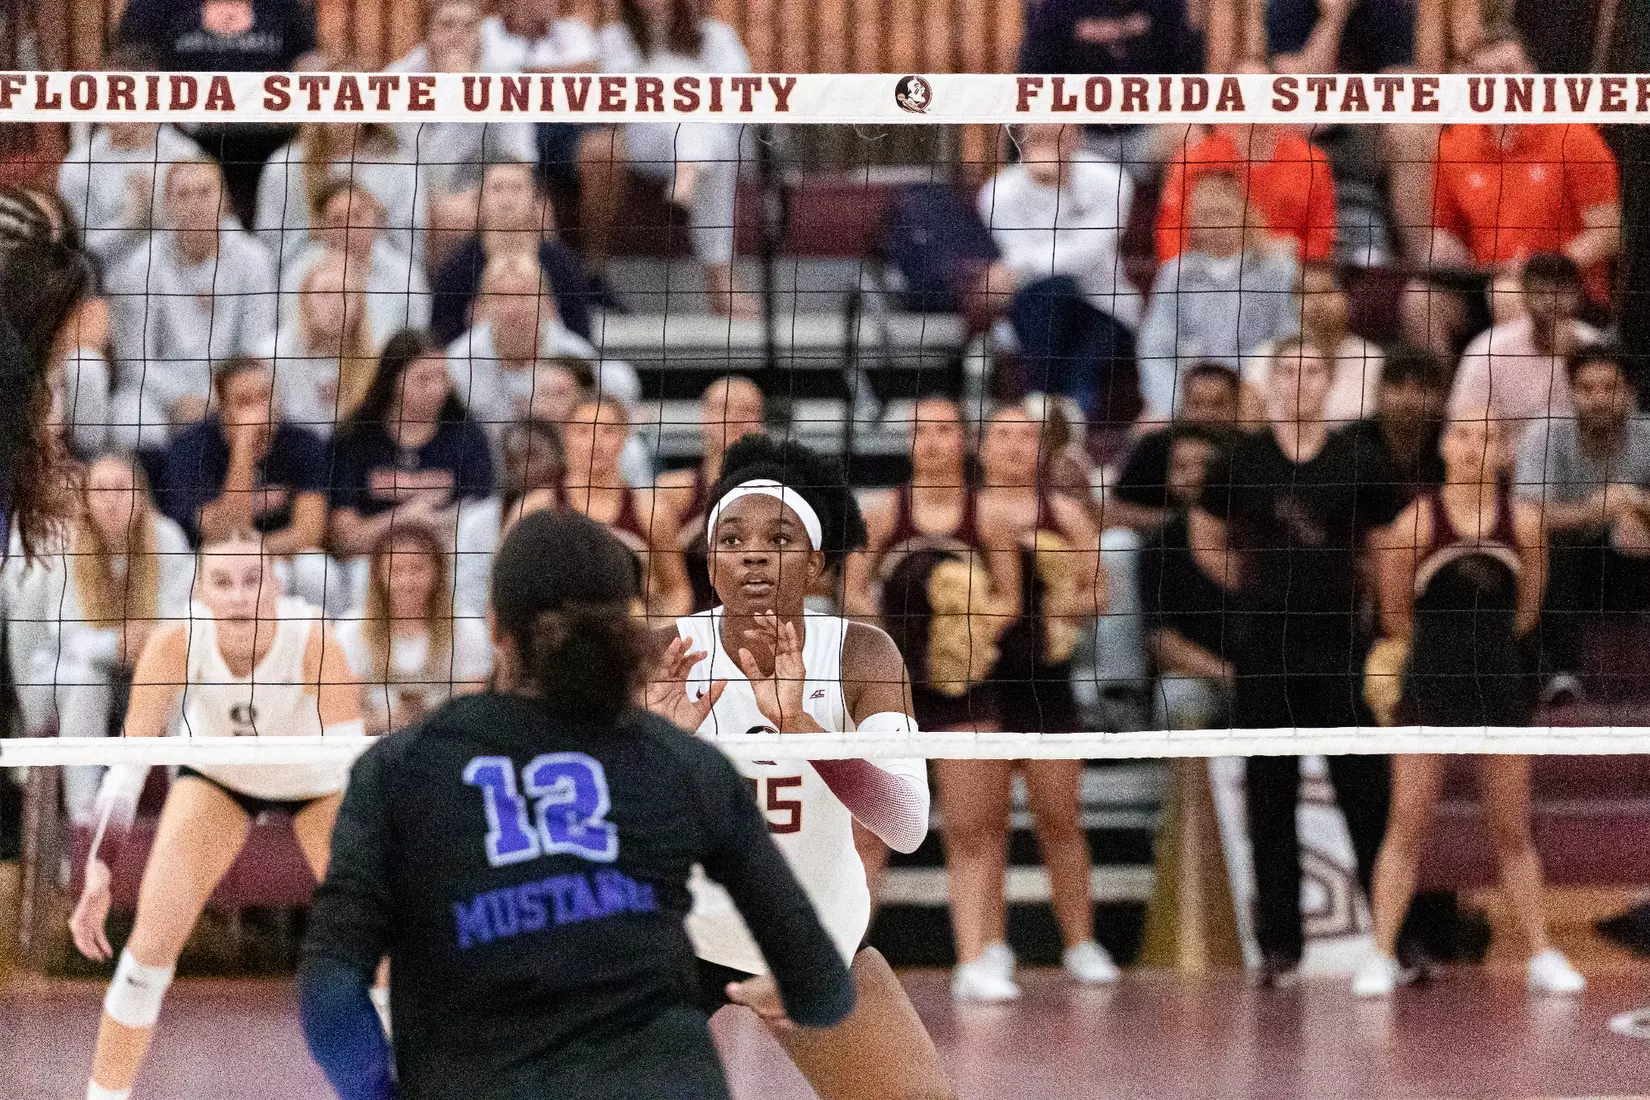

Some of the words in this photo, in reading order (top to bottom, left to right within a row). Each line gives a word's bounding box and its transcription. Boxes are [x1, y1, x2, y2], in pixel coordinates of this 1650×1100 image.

[0, 75, 236, 112] FLORIDA
[263, 75, 436, 112] STATE
[462, 76, 797, 112] UNIVERSITY
[1015, 77, 1246, 112] FLORIDA
[1271, 77, 1440, 112] STATE
[463, 751, 619, 867] 12
[746, 775, 802, 834] 5
